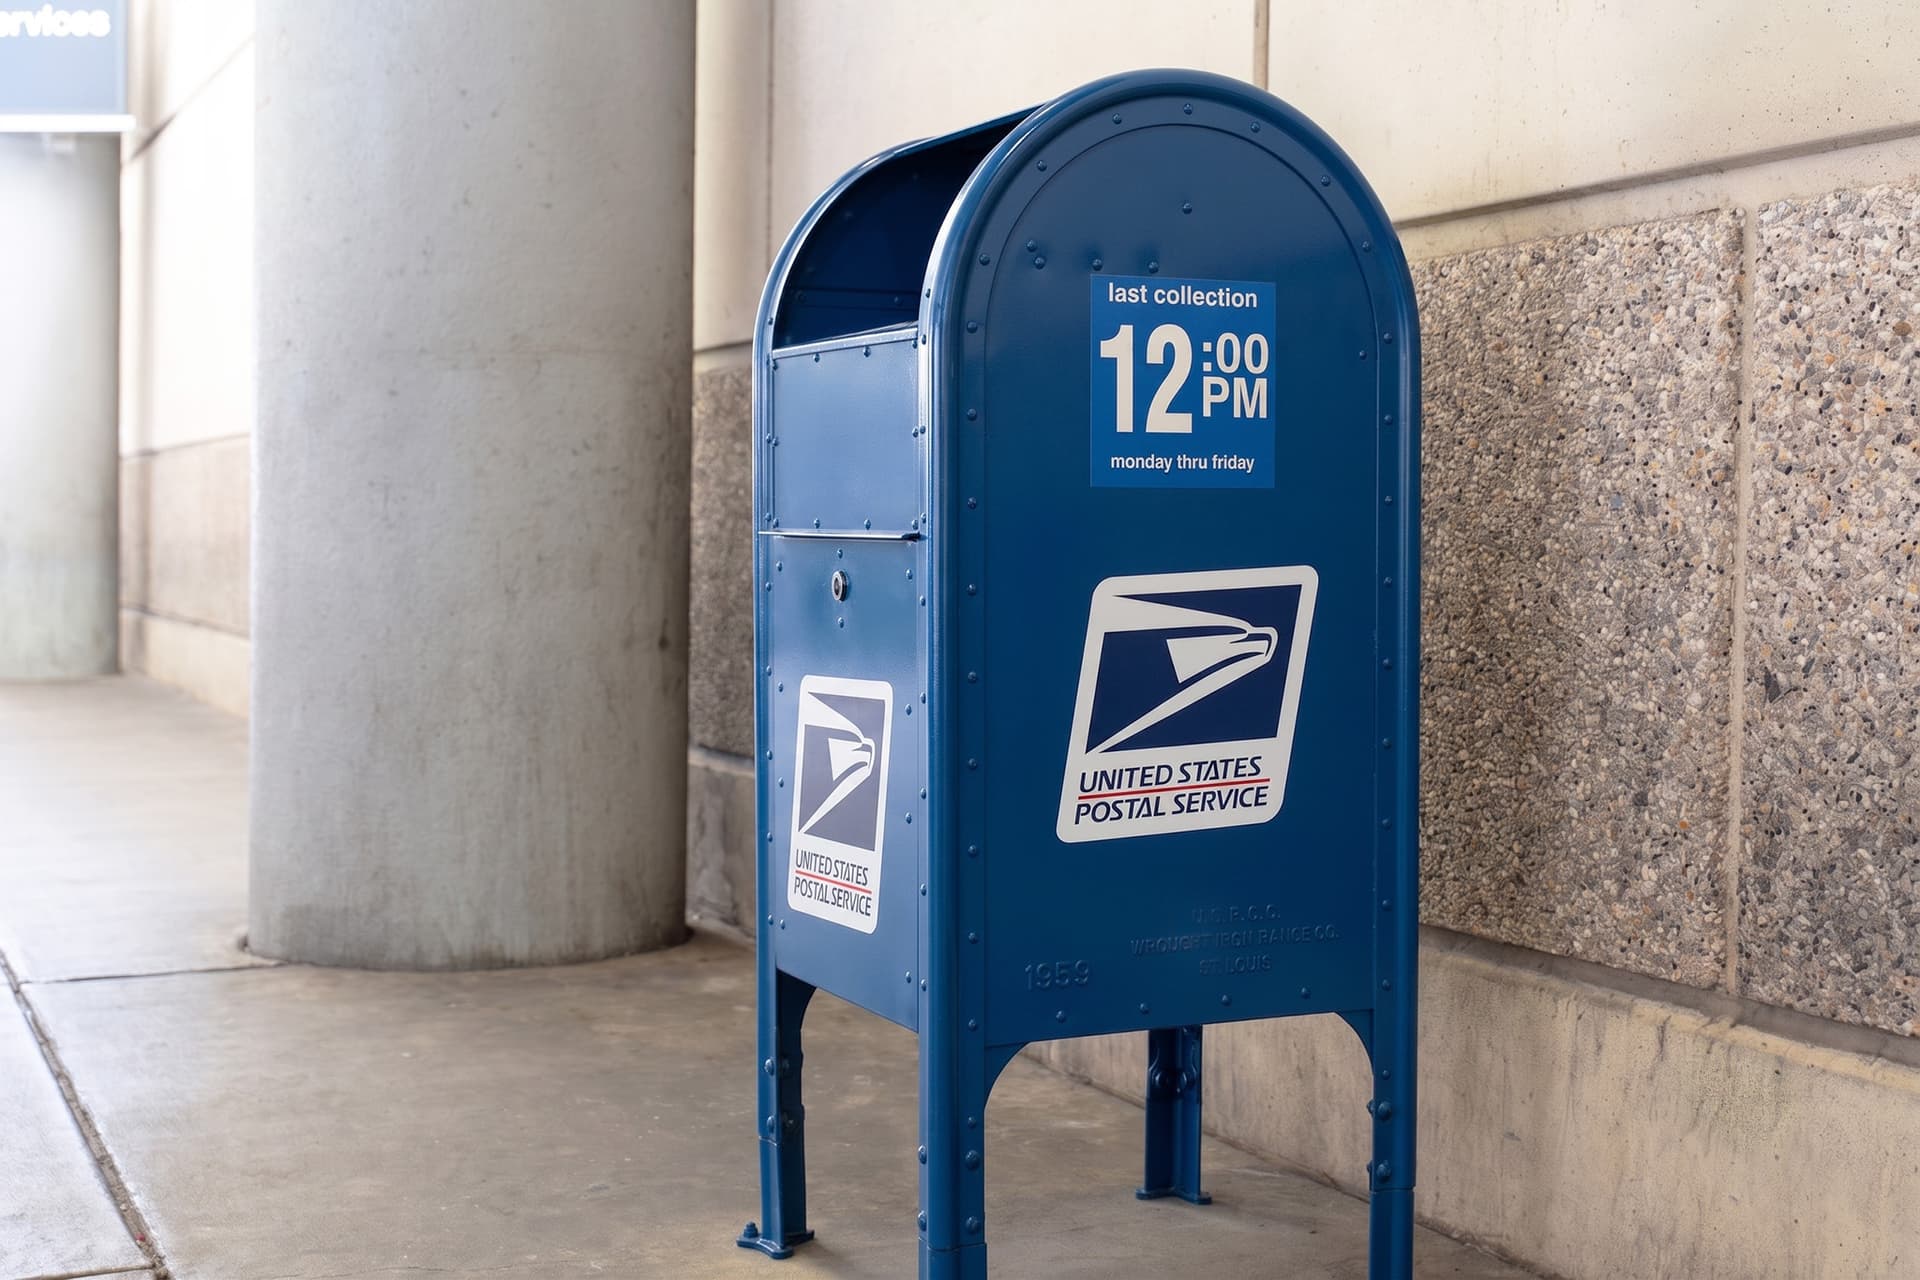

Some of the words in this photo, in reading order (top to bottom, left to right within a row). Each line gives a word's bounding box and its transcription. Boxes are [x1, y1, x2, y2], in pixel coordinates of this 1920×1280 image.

[1108, 282, 1148, 303] last
[1154, 285, 1258, 308] collection
[1202, 376, 1268, 419] PM
[1111, 454, 1173, 473] monday
[1176, 454, 1207, 470] thru
[1212, 454, 1255, 473] friday
[1079, 764, 1173, 793] UNITED
[1178, 755, 1262, 784] STATES
[1075, 795, 1166, 825] POSTAL
[1172, 785, 1269, 815] SERVICE
[795, 848, 833, 876] UNITED
[833, 860, 869, 887] STATES
[794, 877, 830, 904] POSTAL
[831, 887, 872, 917] SERVICE
[1024, 959, 1090, 991] 1959
[1225, 953, 1273, 975] LOUIS
